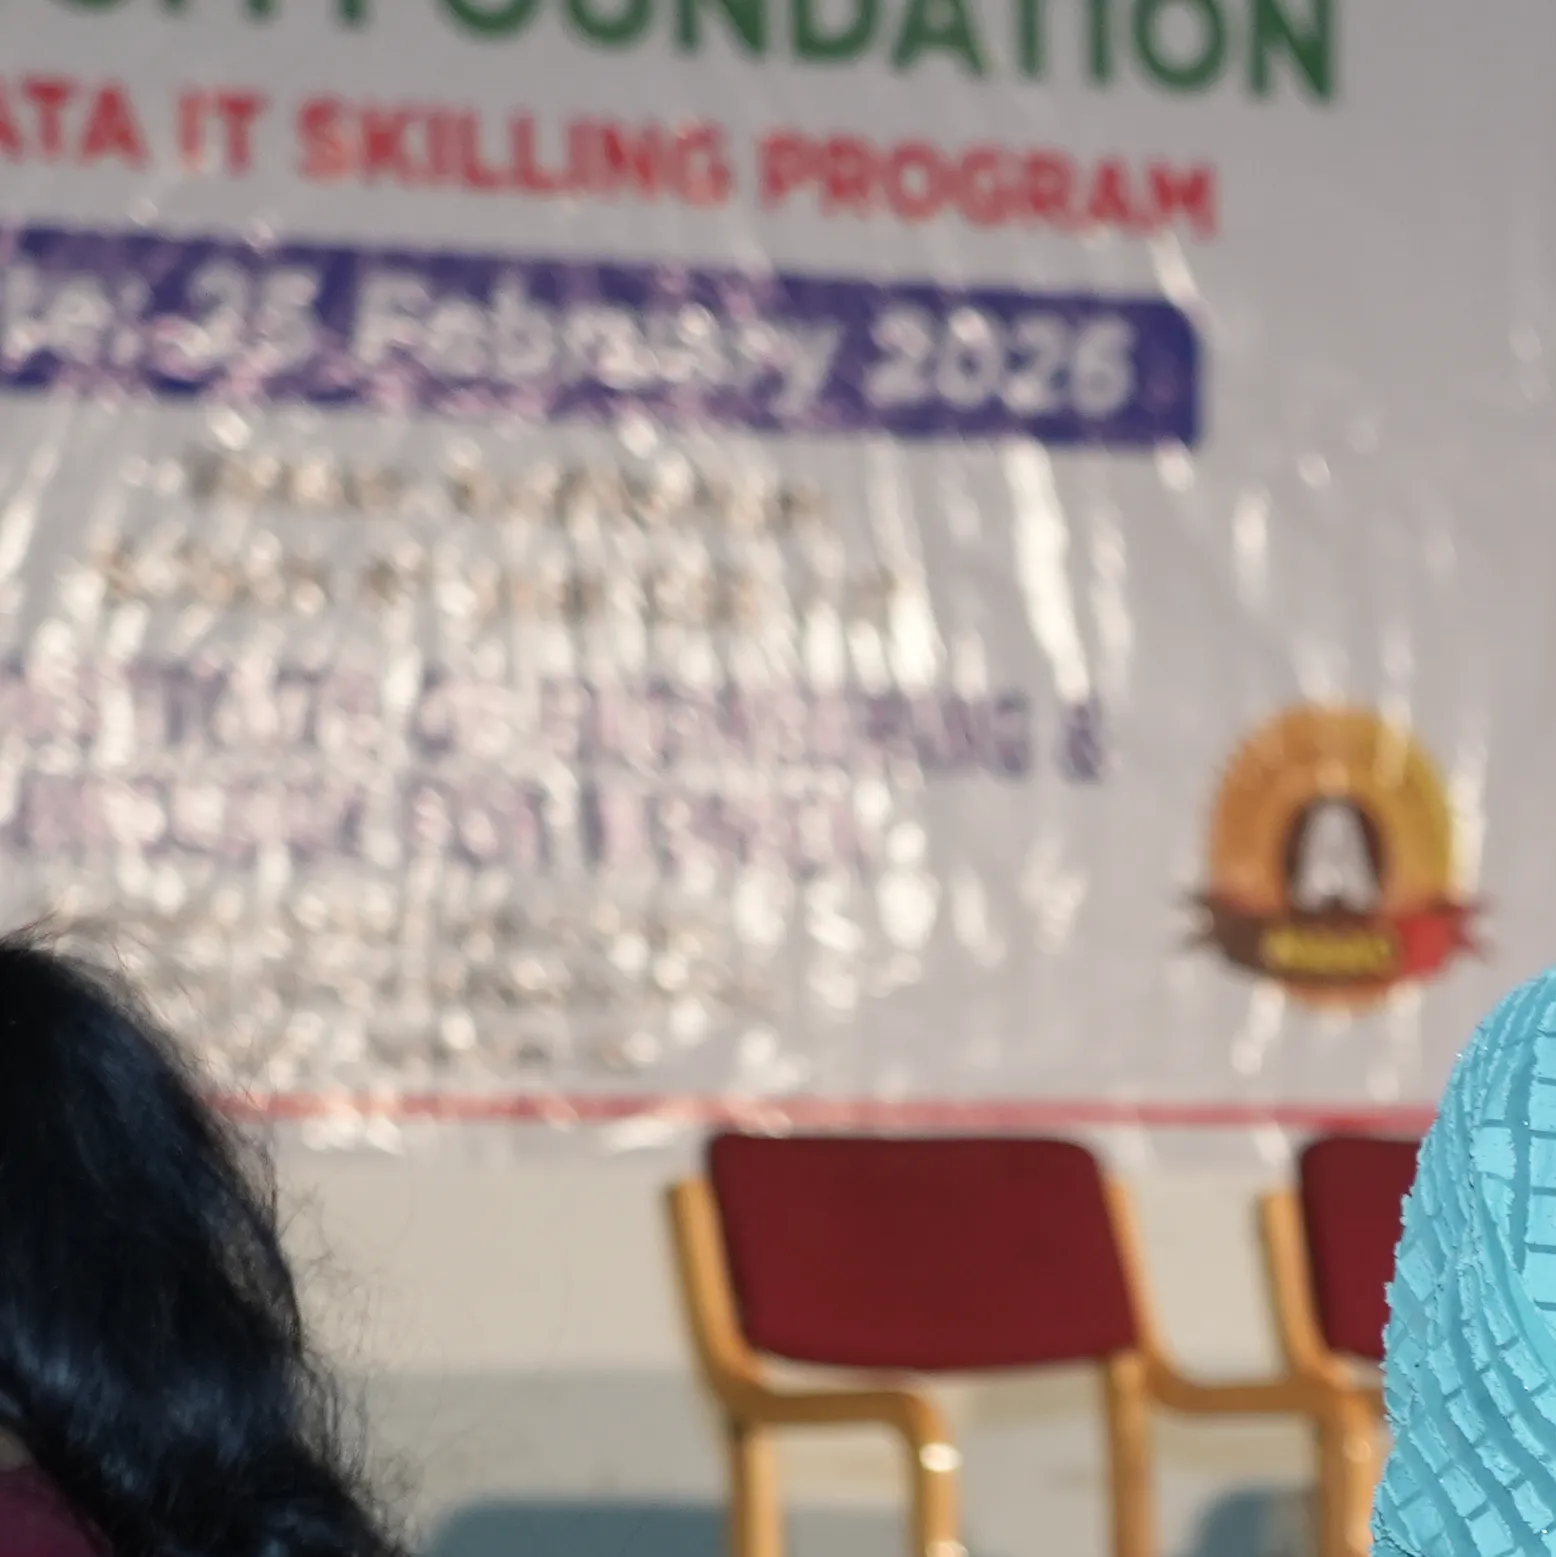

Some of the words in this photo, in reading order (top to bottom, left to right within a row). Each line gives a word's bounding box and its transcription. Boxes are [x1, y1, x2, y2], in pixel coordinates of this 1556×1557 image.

[175, 85, 262, 178] IT
[296, 90, 732, 208] SKILLING
[758, 130, 1220, 240] PROGRAM
[868, 296, 1140, 420] 2026
